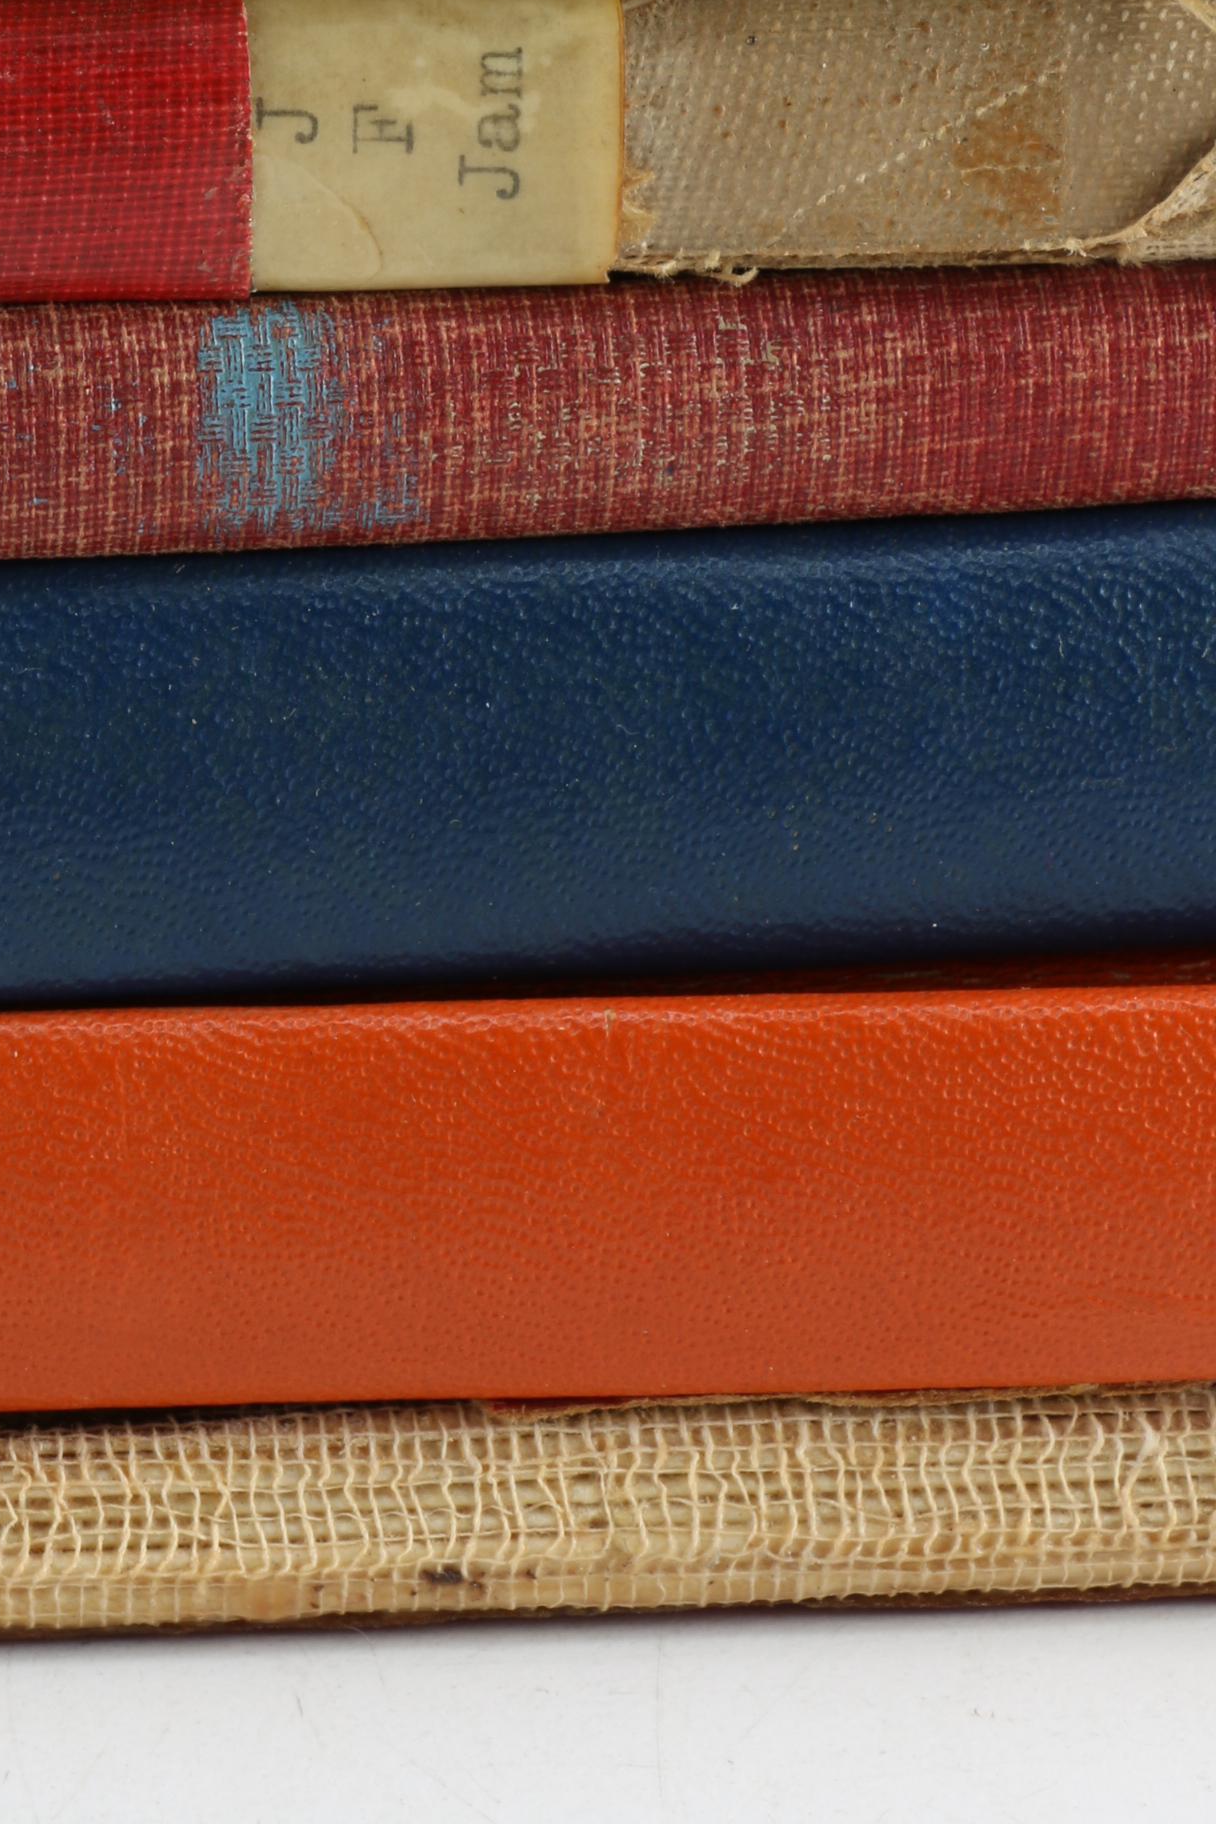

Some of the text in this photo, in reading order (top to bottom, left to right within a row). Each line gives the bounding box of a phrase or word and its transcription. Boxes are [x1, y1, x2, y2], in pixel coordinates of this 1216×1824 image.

[255, 97, 319, 145] J
[352, 104, 414, 154] F
[458, 46, 523, 200] Jam
